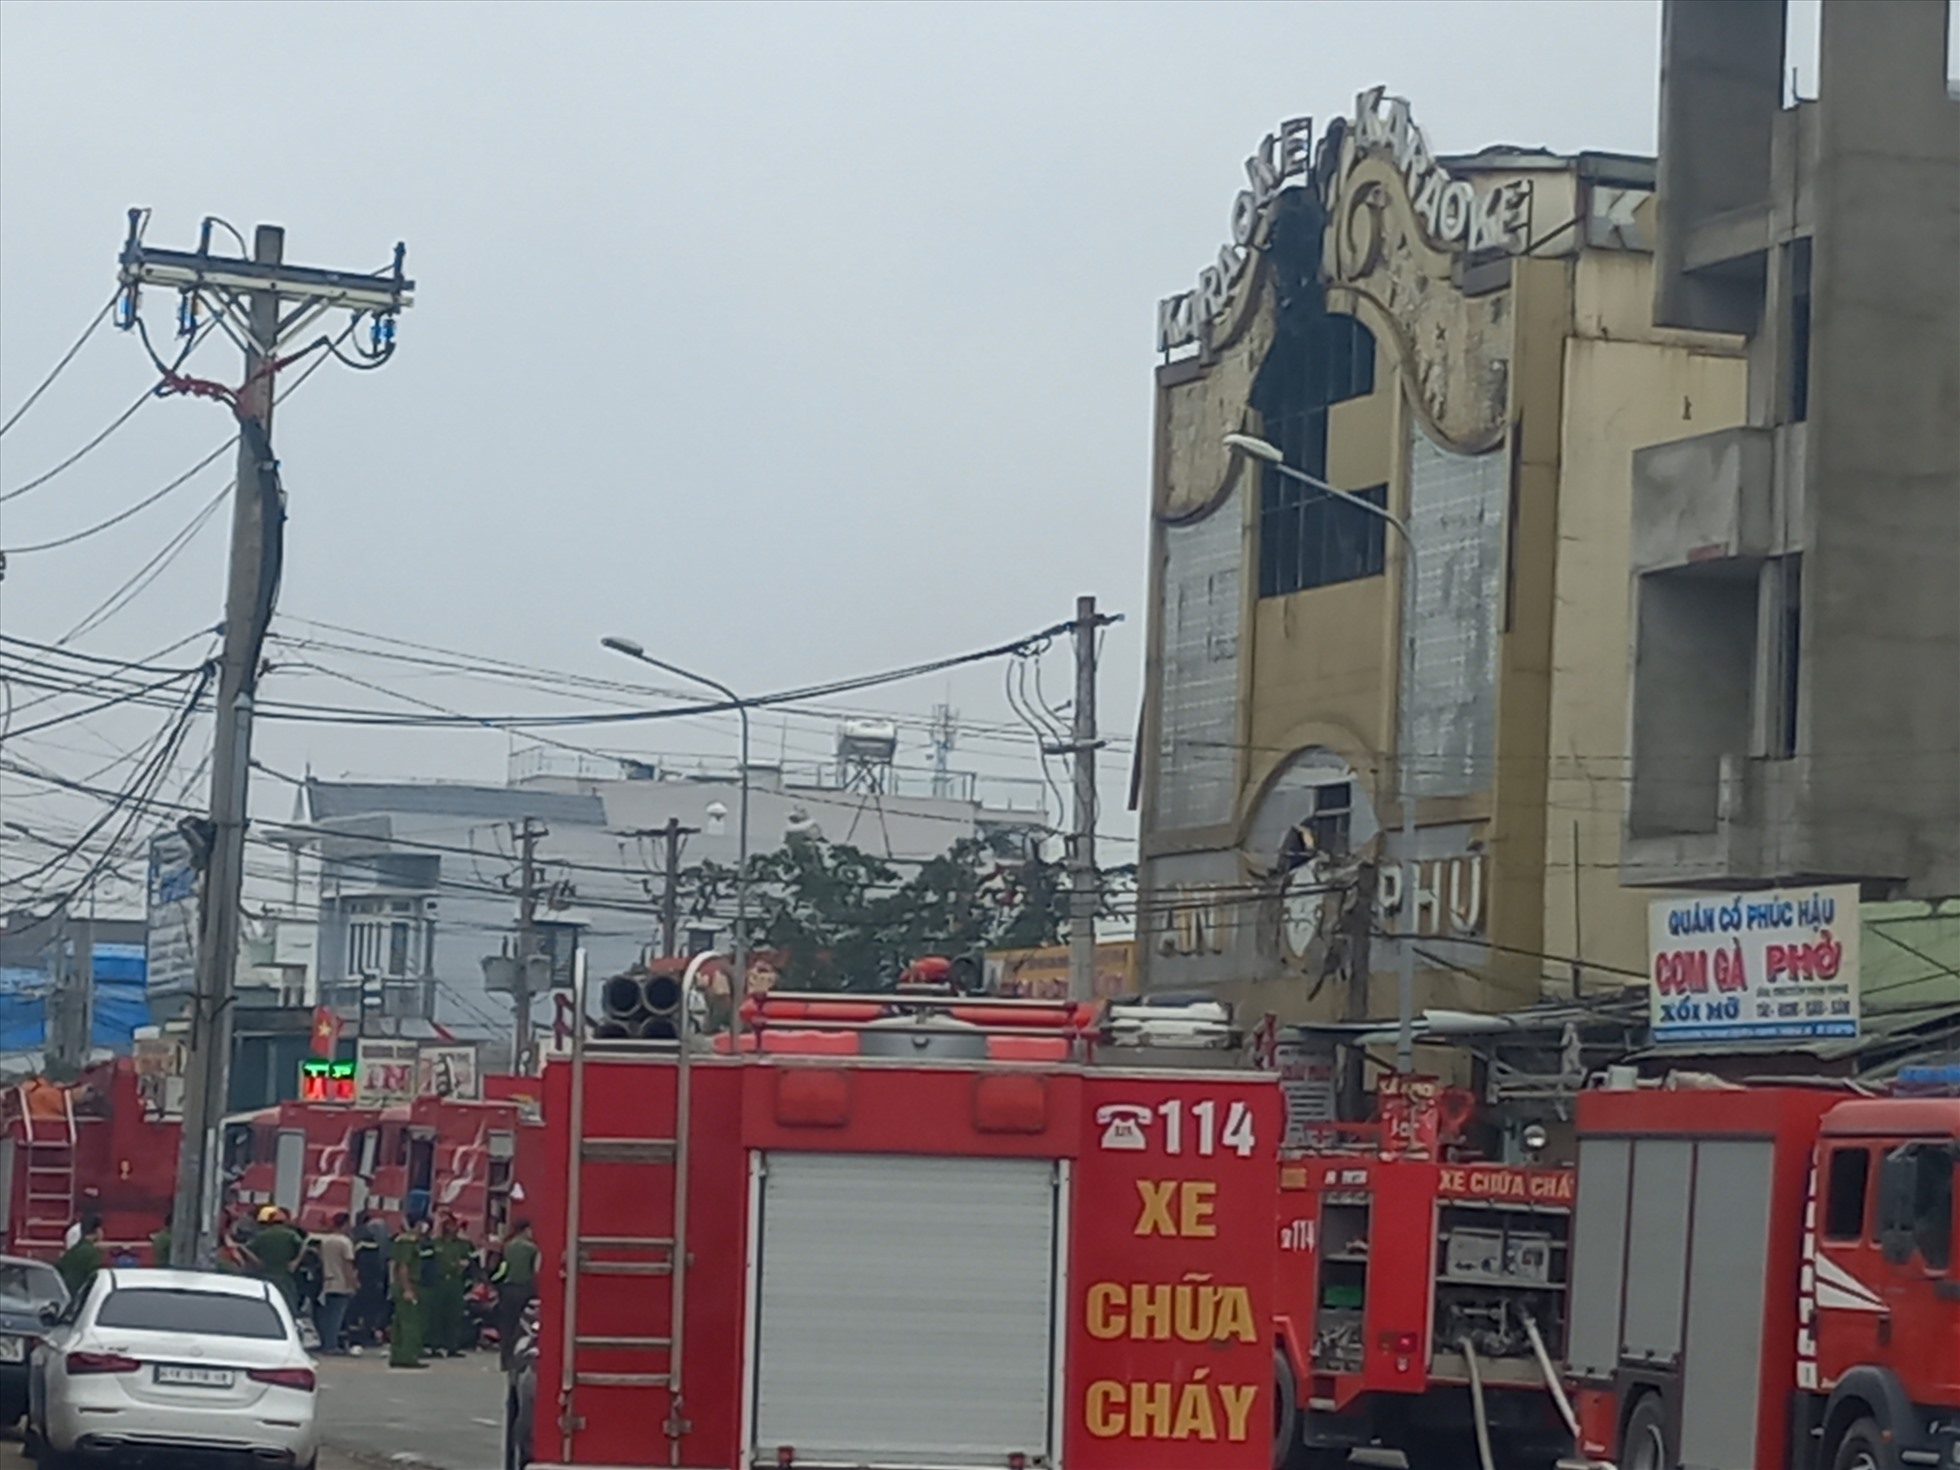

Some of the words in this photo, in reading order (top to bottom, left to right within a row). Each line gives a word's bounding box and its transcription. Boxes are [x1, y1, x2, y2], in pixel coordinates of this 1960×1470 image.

[1355, 86, 1533, 251] KARAOKE
[1157, 116, 1313, 352] KARAOKE
[1668, 901, 1715, 936] QUÁN
[1747, 895, 1793, 931] PHÚC
[1798, 892, 1835, 932] HẬU
[1714, 936, 1748, 994] GÀ
[1766, 930, 1842, 983] PHỞ
[1158, 1099, 1255, 1156] 114
[1134, 1179, 1217, 1236] XE
[1438, 1169, 1466, 1192] XE
[1529, 1172, 1575, 1198] CHÁ
[1086, 1273, 1257, 1343] CHỮA
[1085, 1367, 1257, 1441] CHÁY
